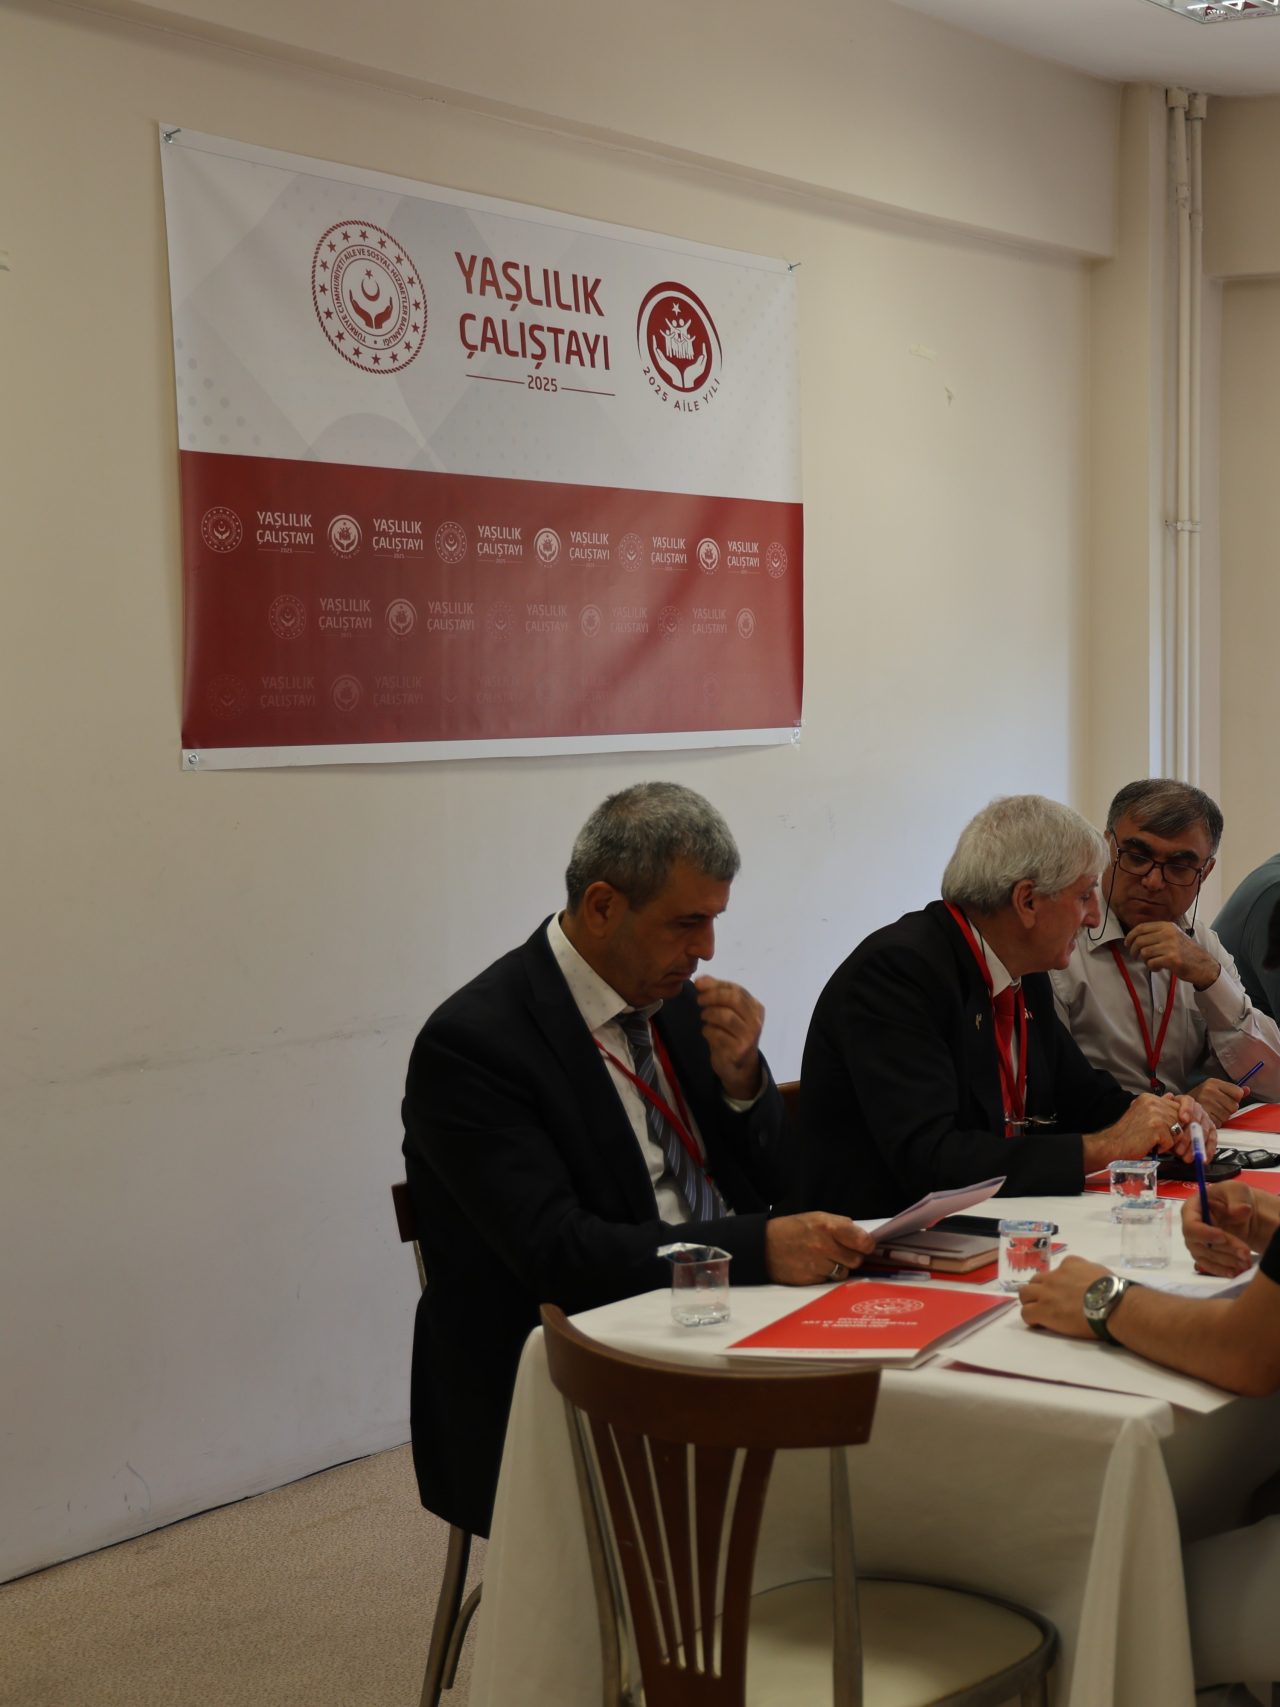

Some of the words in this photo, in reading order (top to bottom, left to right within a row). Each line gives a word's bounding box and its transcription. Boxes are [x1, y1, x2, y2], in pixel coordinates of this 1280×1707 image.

[366, 249, 391, 270] SOSYAL
[454, 251, 605, 317] YAŞLILIK
[459, 312, 611, 371] ÇALIŞTAYI
[527, 375, 558, 393] 2025
[643, 366, 669, 402] 2025
[674, 400, 701, 413] AİLE
[702, 379, 721, 405] YILI
[256, 511, 312, 529] YAŞLILIK
[372, 518, 422, 535] YAŞLILIK
[256, 530, 314, 547] ÇALIŞTAYI
[477, 525, 522, 541] YAŞLILIK
[570, 531, 609, 546] YAŞLILIK
[372, 537, 424, 553] ÇALIŞTAYI
[477, 542, 523, 558] ÇALIŞTAYI
[652, 536, 686, 550] YAŞLILIK
[727, 541, 759, 555] YAŞLILIK
[569, 547, 610, 561] ÇALIŞTAYI
[651, 552, 687, 566] ÇALIŞTAYI
[727, 555, 760, 568] ÇALIŞTAYI
[319, 598, 371, 614] YAŞLILIK
[318, 616, 372, 632] ÇALIŞTAYI
